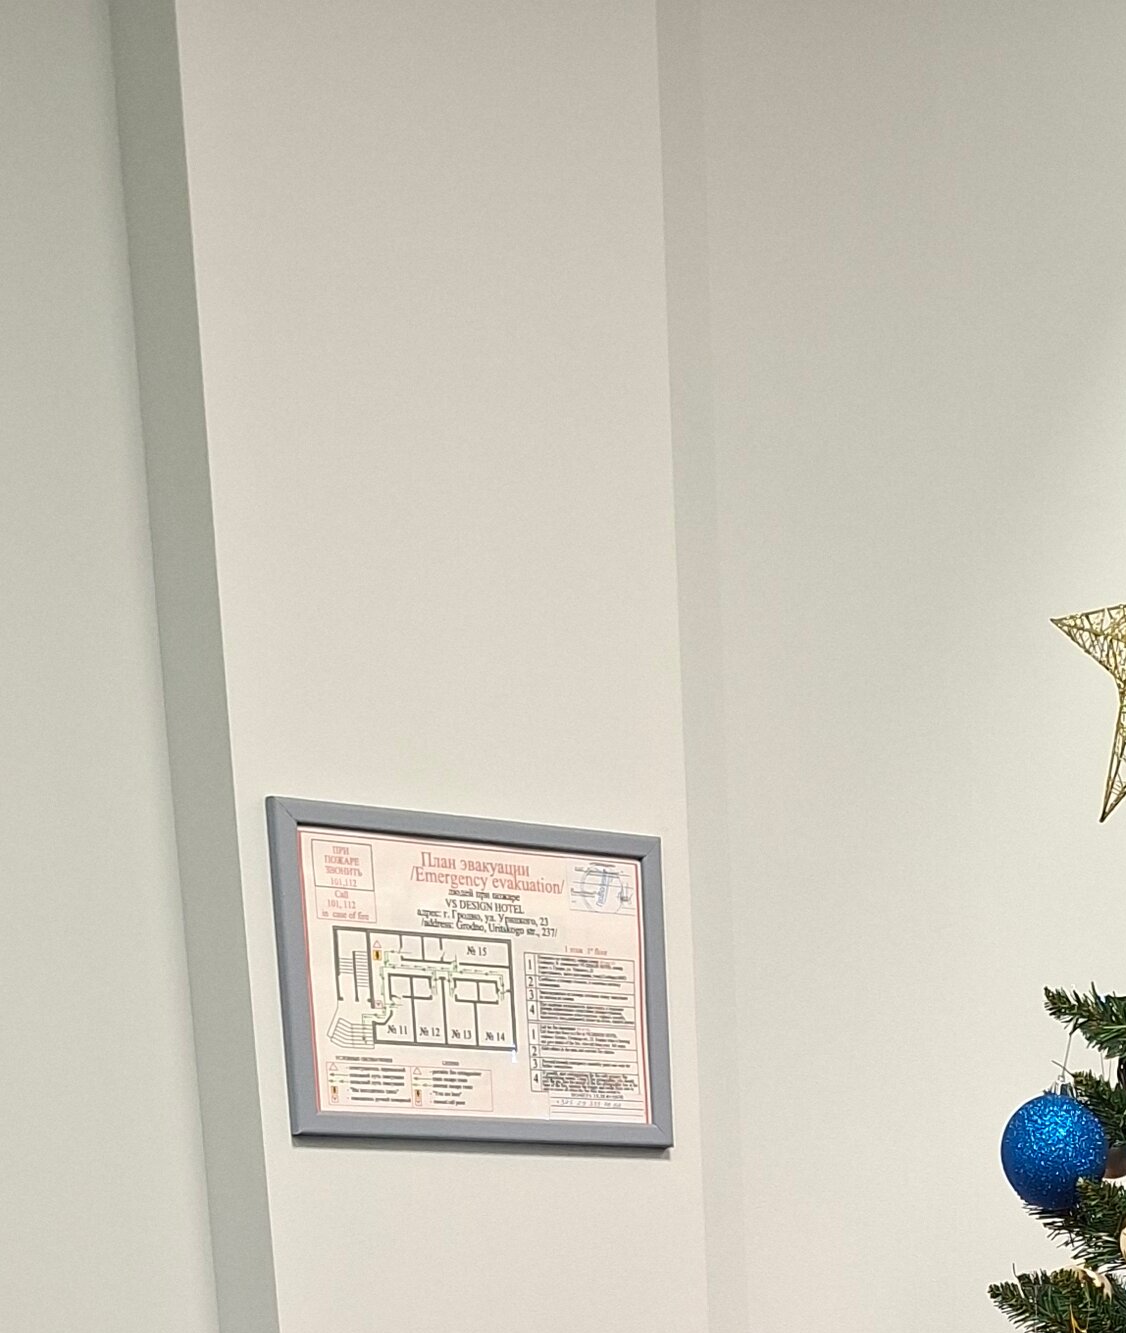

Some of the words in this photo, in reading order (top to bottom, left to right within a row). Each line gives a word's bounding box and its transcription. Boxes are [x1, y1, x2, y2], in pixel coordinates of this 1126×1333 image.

[324, 855, 360, 866] ПОЖАРЕ
[421, 851, 456, 870] План
[460, 858, 530, 877] эвакуации
[410, 866, 488, 890] /Emergency
[492, 877, 565, 894] evakuation/
[445, 898, 458, 909] VS
[459, 900, 493, 911] DESIGN
[494, 903, 524, 914] HOTEL
[539, 917, 549, 926] 23
[478, 947, 487, 956] 15
[398, 1025, 408, 1035] 11
[431, 1027, 441, 1037] 12
[463, 1029, 472, 1040] 13
[496, 1031, 505, 1041] 14
